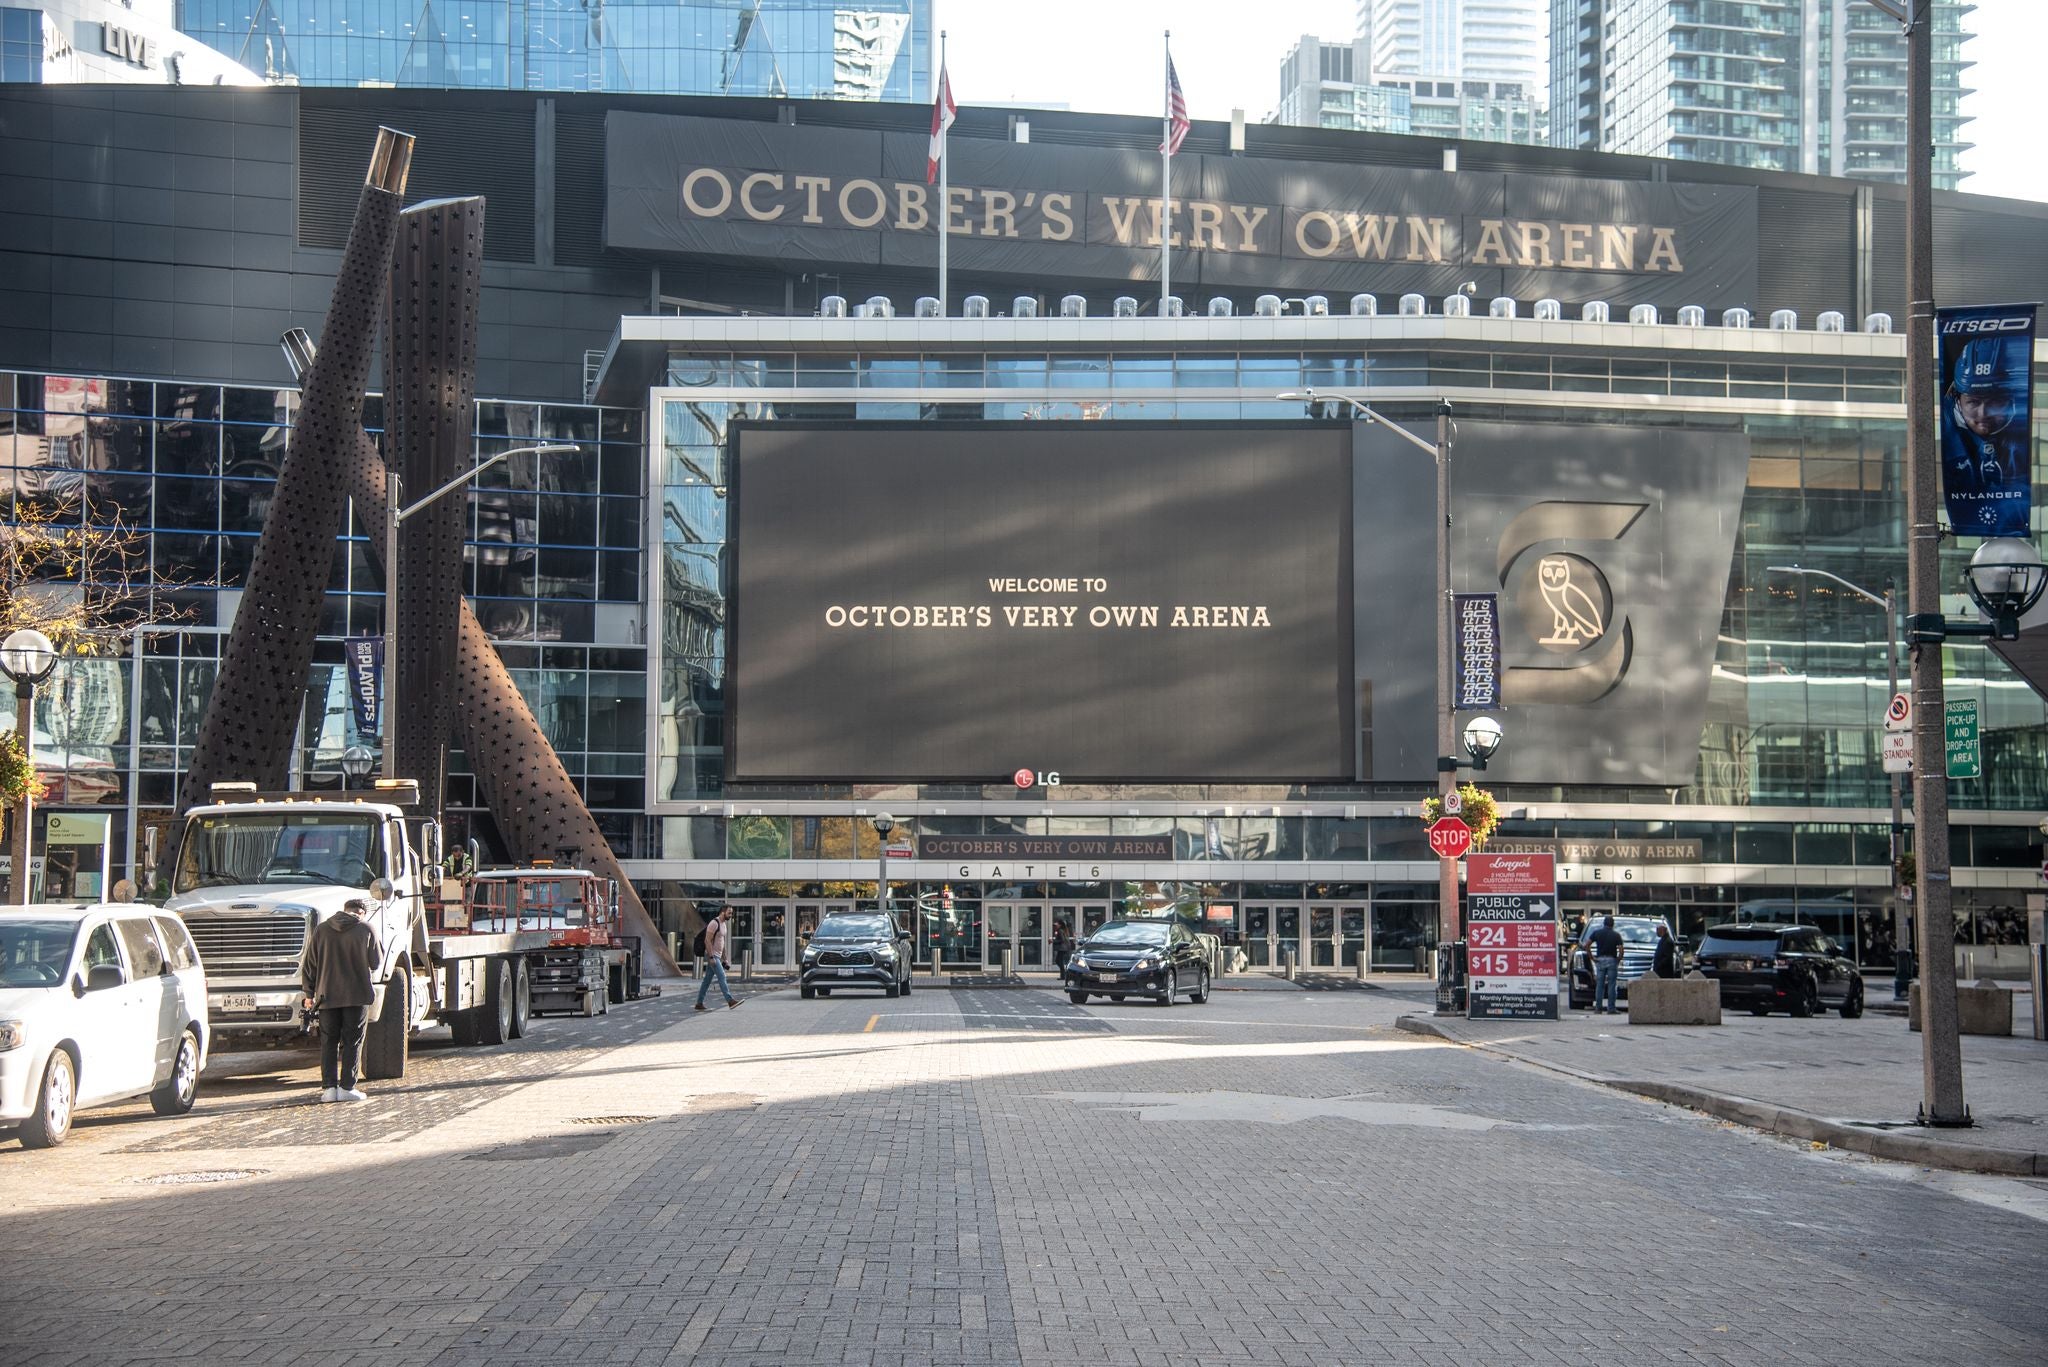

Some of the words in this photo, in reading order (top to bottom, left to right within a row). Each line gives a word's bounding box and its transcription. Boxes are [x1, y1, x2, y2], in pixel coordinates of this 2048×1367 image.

[682, 168, 1074, 241] OCTOBER'S
[1103, 198, 1268, 253] VERY
[1296, 211, 1446, 262] OWN
[1472, 219, 1684, 272] ARENA
[1942, 320, 1980, 333] LET'S
[1976, 364, 1991, 375] 88
[1952, 492, 2022, 500] NYLANDER
[989, 578, 1078, 592] WELCOME
[1083, 578, 1107, 592] TO
[1464, 600, 1490, 610] LET'S
[825, 605, 992, 627] OCTOBER'S
[1003, 606, 1078, 627] VERY
[1089, 606, 1159, 627] OWN
[1170, 606, 1272, 627] ARENA
[358, 656, 375, 722] PLAYOFFS
[1946, 702, 1976, 712] PASSENGER
[1947, 716, 1976, 726] PICK-UP
[1954, 728, 1969, 738] AND
[1894, 738, 1903, 747] NO
[1946, 740, 1978, 750] DROP-OFF
[1884, 749, 1914, 759] STANDING
[1952, 753, 1973, 763] AREA
[1038, 772, 1060, 786] LG
[1433, 830, 1468, 845] STOP
[926, 841, 1017, 854] OCTOBER'S
[1024, 842, 1063, 854] VERY
[1068, 842, 1106, 854] OWN
[1113, 842, 1167, 854] ARENA
[1562, 845, 1599, 858] VERY
[1604, 846, 1640, 858] OWN
[1647, 846, 1696, 858] ARENA
[960, 866, 1067, 877] GATE
[1091, 866, 1099, 877] 6
[1624, 870, 1632, 880] 6
[1477, 897, 1520, 907] PUBLIC
[1472, 909, 1525, 919] PARKING
[1472, 927, 1506, 946] $24
[1472, 954, 1508, 973] $15
